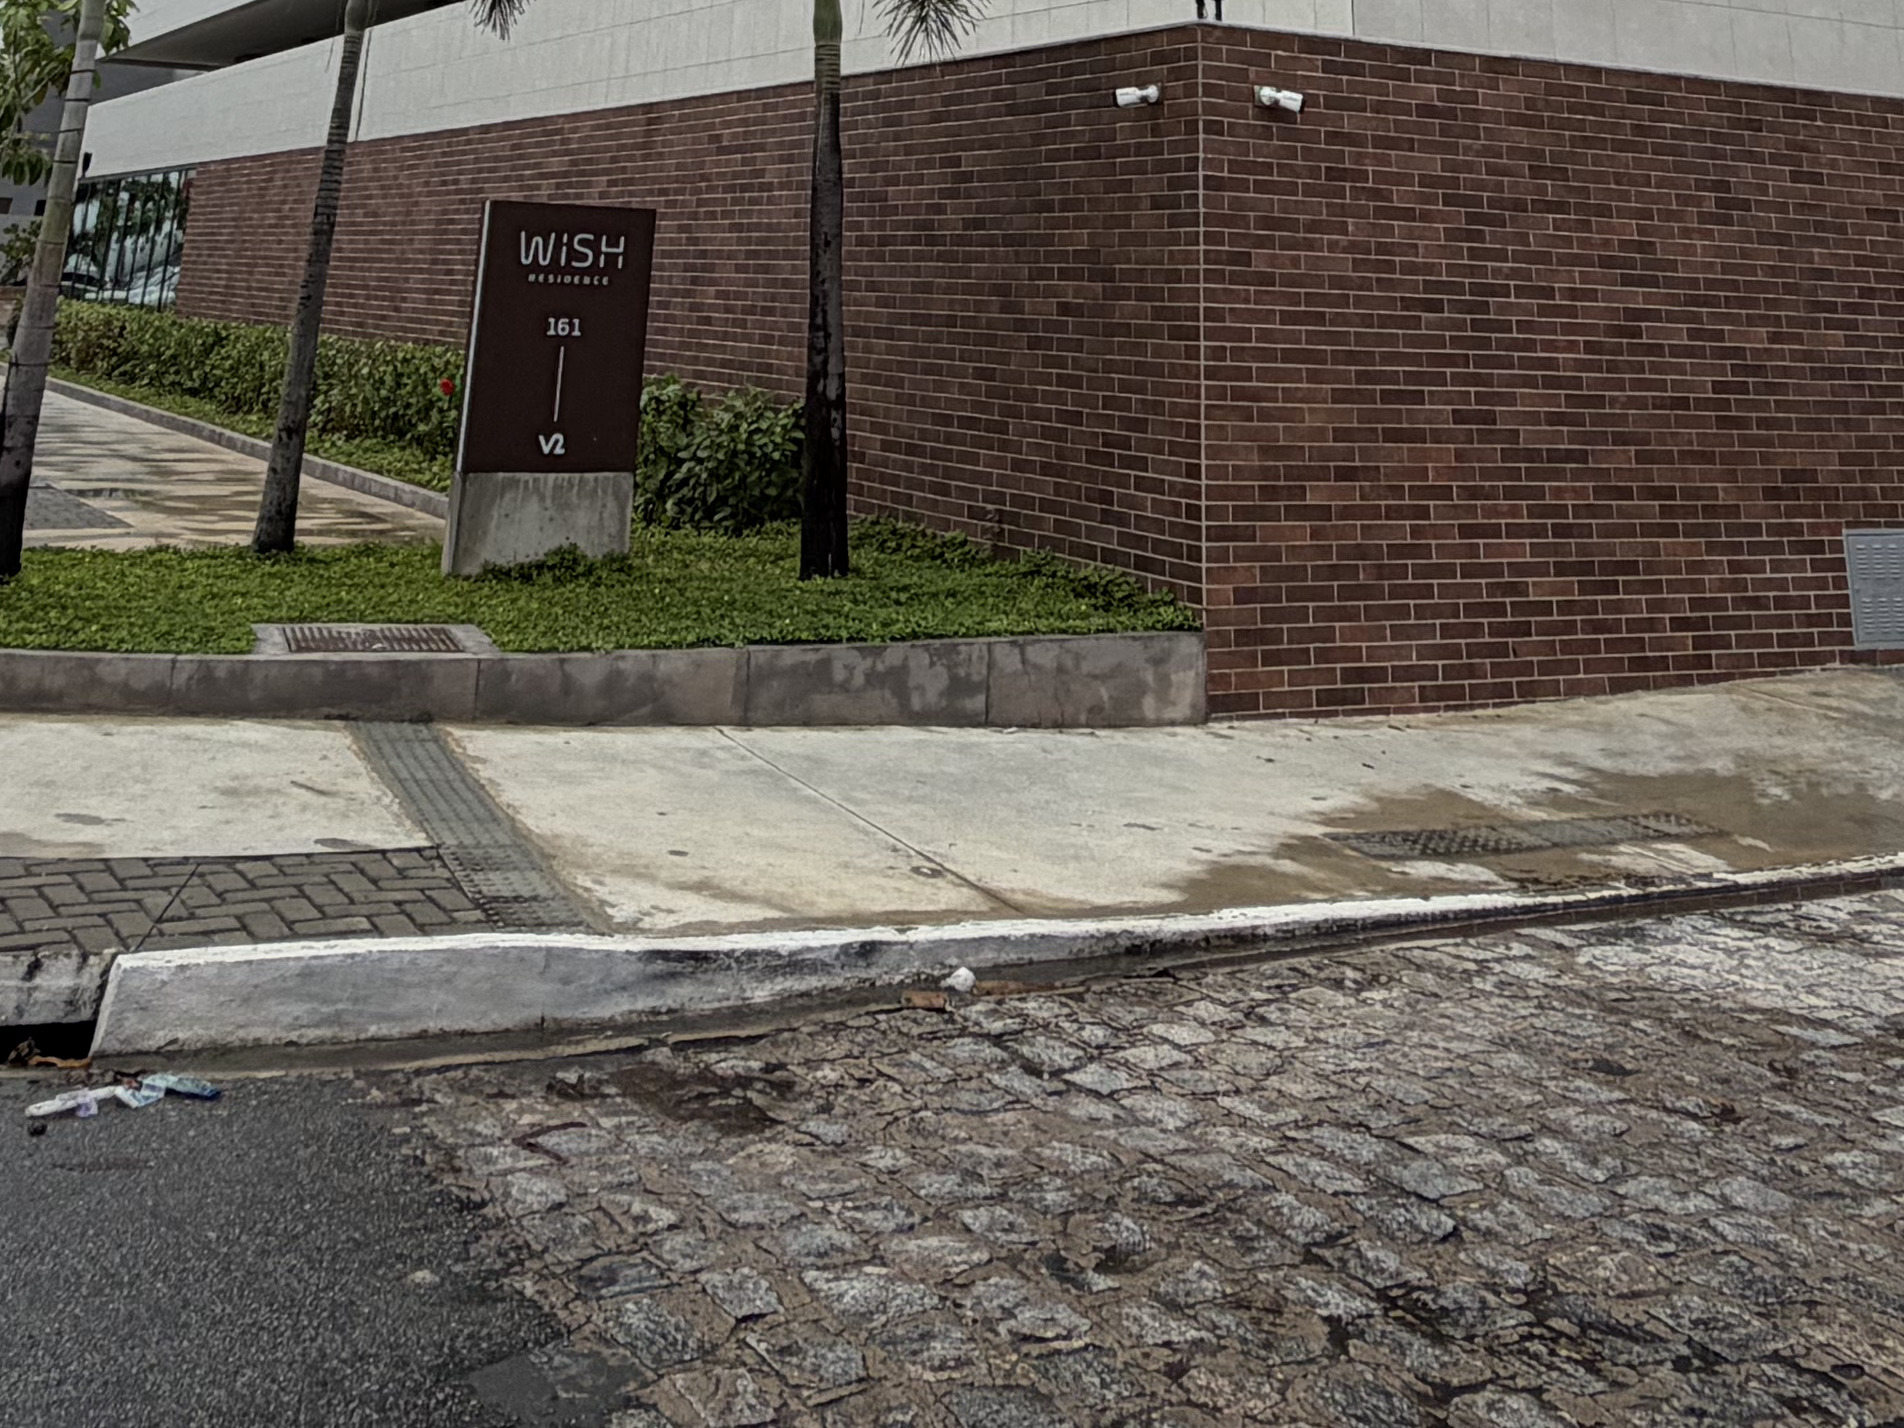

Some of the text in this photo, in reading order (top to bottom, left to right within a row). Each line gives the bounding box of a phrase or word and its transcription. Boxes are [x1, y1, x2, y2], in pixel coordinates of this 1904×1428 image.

[527, 273, 610, 286] RESIDENCE
[546, 316, 582, 337] 161
[538, 432, 566, 455] V2
